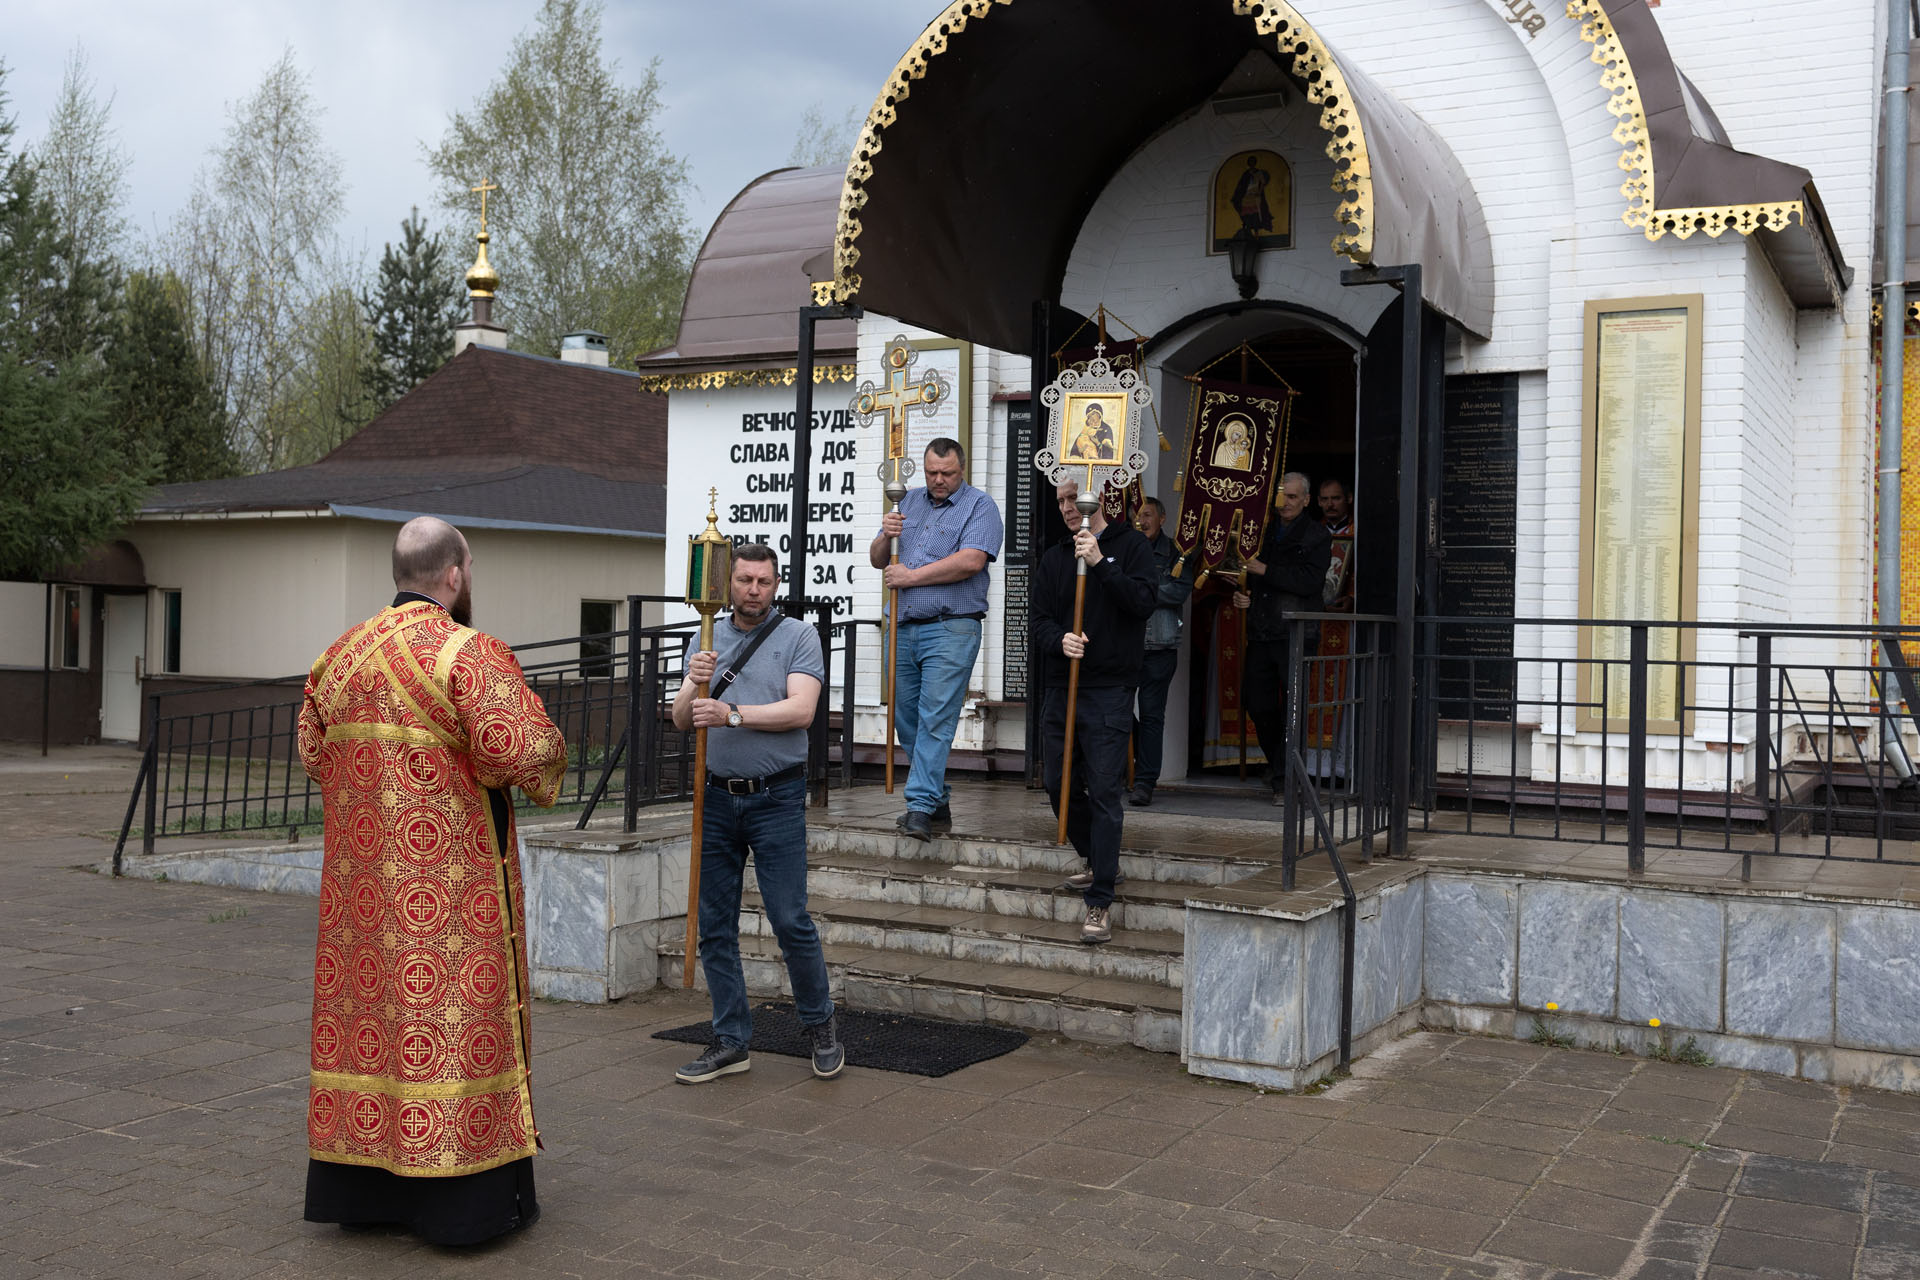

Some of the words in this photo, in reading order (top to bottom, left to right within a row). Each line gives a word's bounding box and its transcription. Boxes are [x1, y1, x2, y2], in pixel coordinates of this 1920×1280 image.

[742, 411, 797, 432] ВЕЧНО
[730, 442, 790, 463] СЛАВА
[746, 472, 796, 493] СЫНА
[819, 472, 831, 492] И
[841, 471, 855, 495] Д
[728, 503, 788, 523] ЗЕМЛИ
[808, 502, 854, 522] ЕРЕС
[779, 533, 853, 557] ОДАЛИ
[812, 564, 838, 585] ЗА
